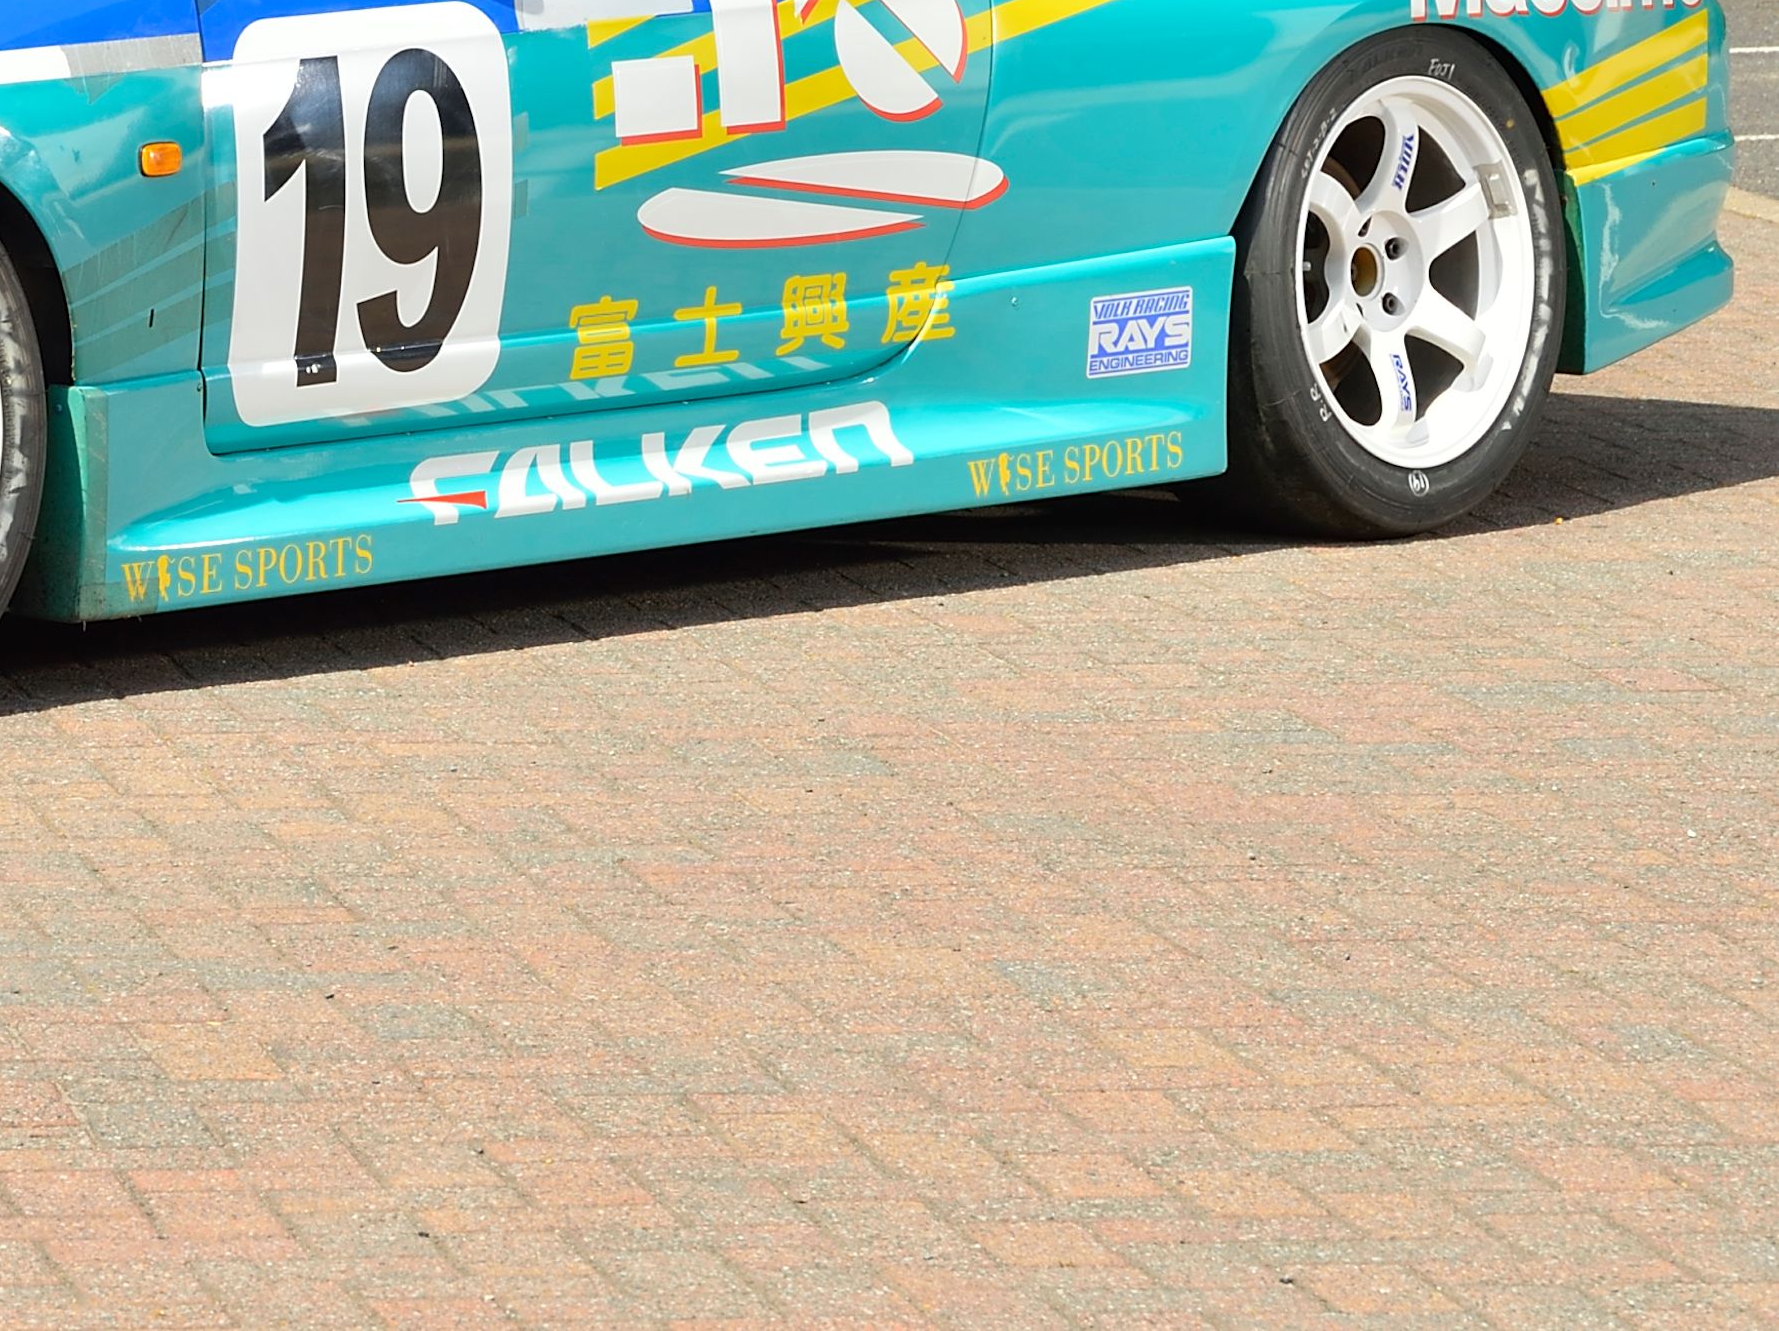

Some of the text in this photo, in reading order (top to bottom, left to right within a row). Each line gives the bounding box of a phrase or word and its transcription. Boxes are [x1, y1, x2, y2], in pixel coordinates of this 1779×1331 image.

[263, 48, 483, 388] 19
[1088, 314, 1191, 355] RAYS
[1093, 293, 1190, 320] VOLK RACING
[1089, 349, 1189, 372] ENGINEERING
[397, 400, 915, 526] FALKEN
[1063, 431, 1184, 487] SPORTS
[233, 535, 374, 591] SPORTS
